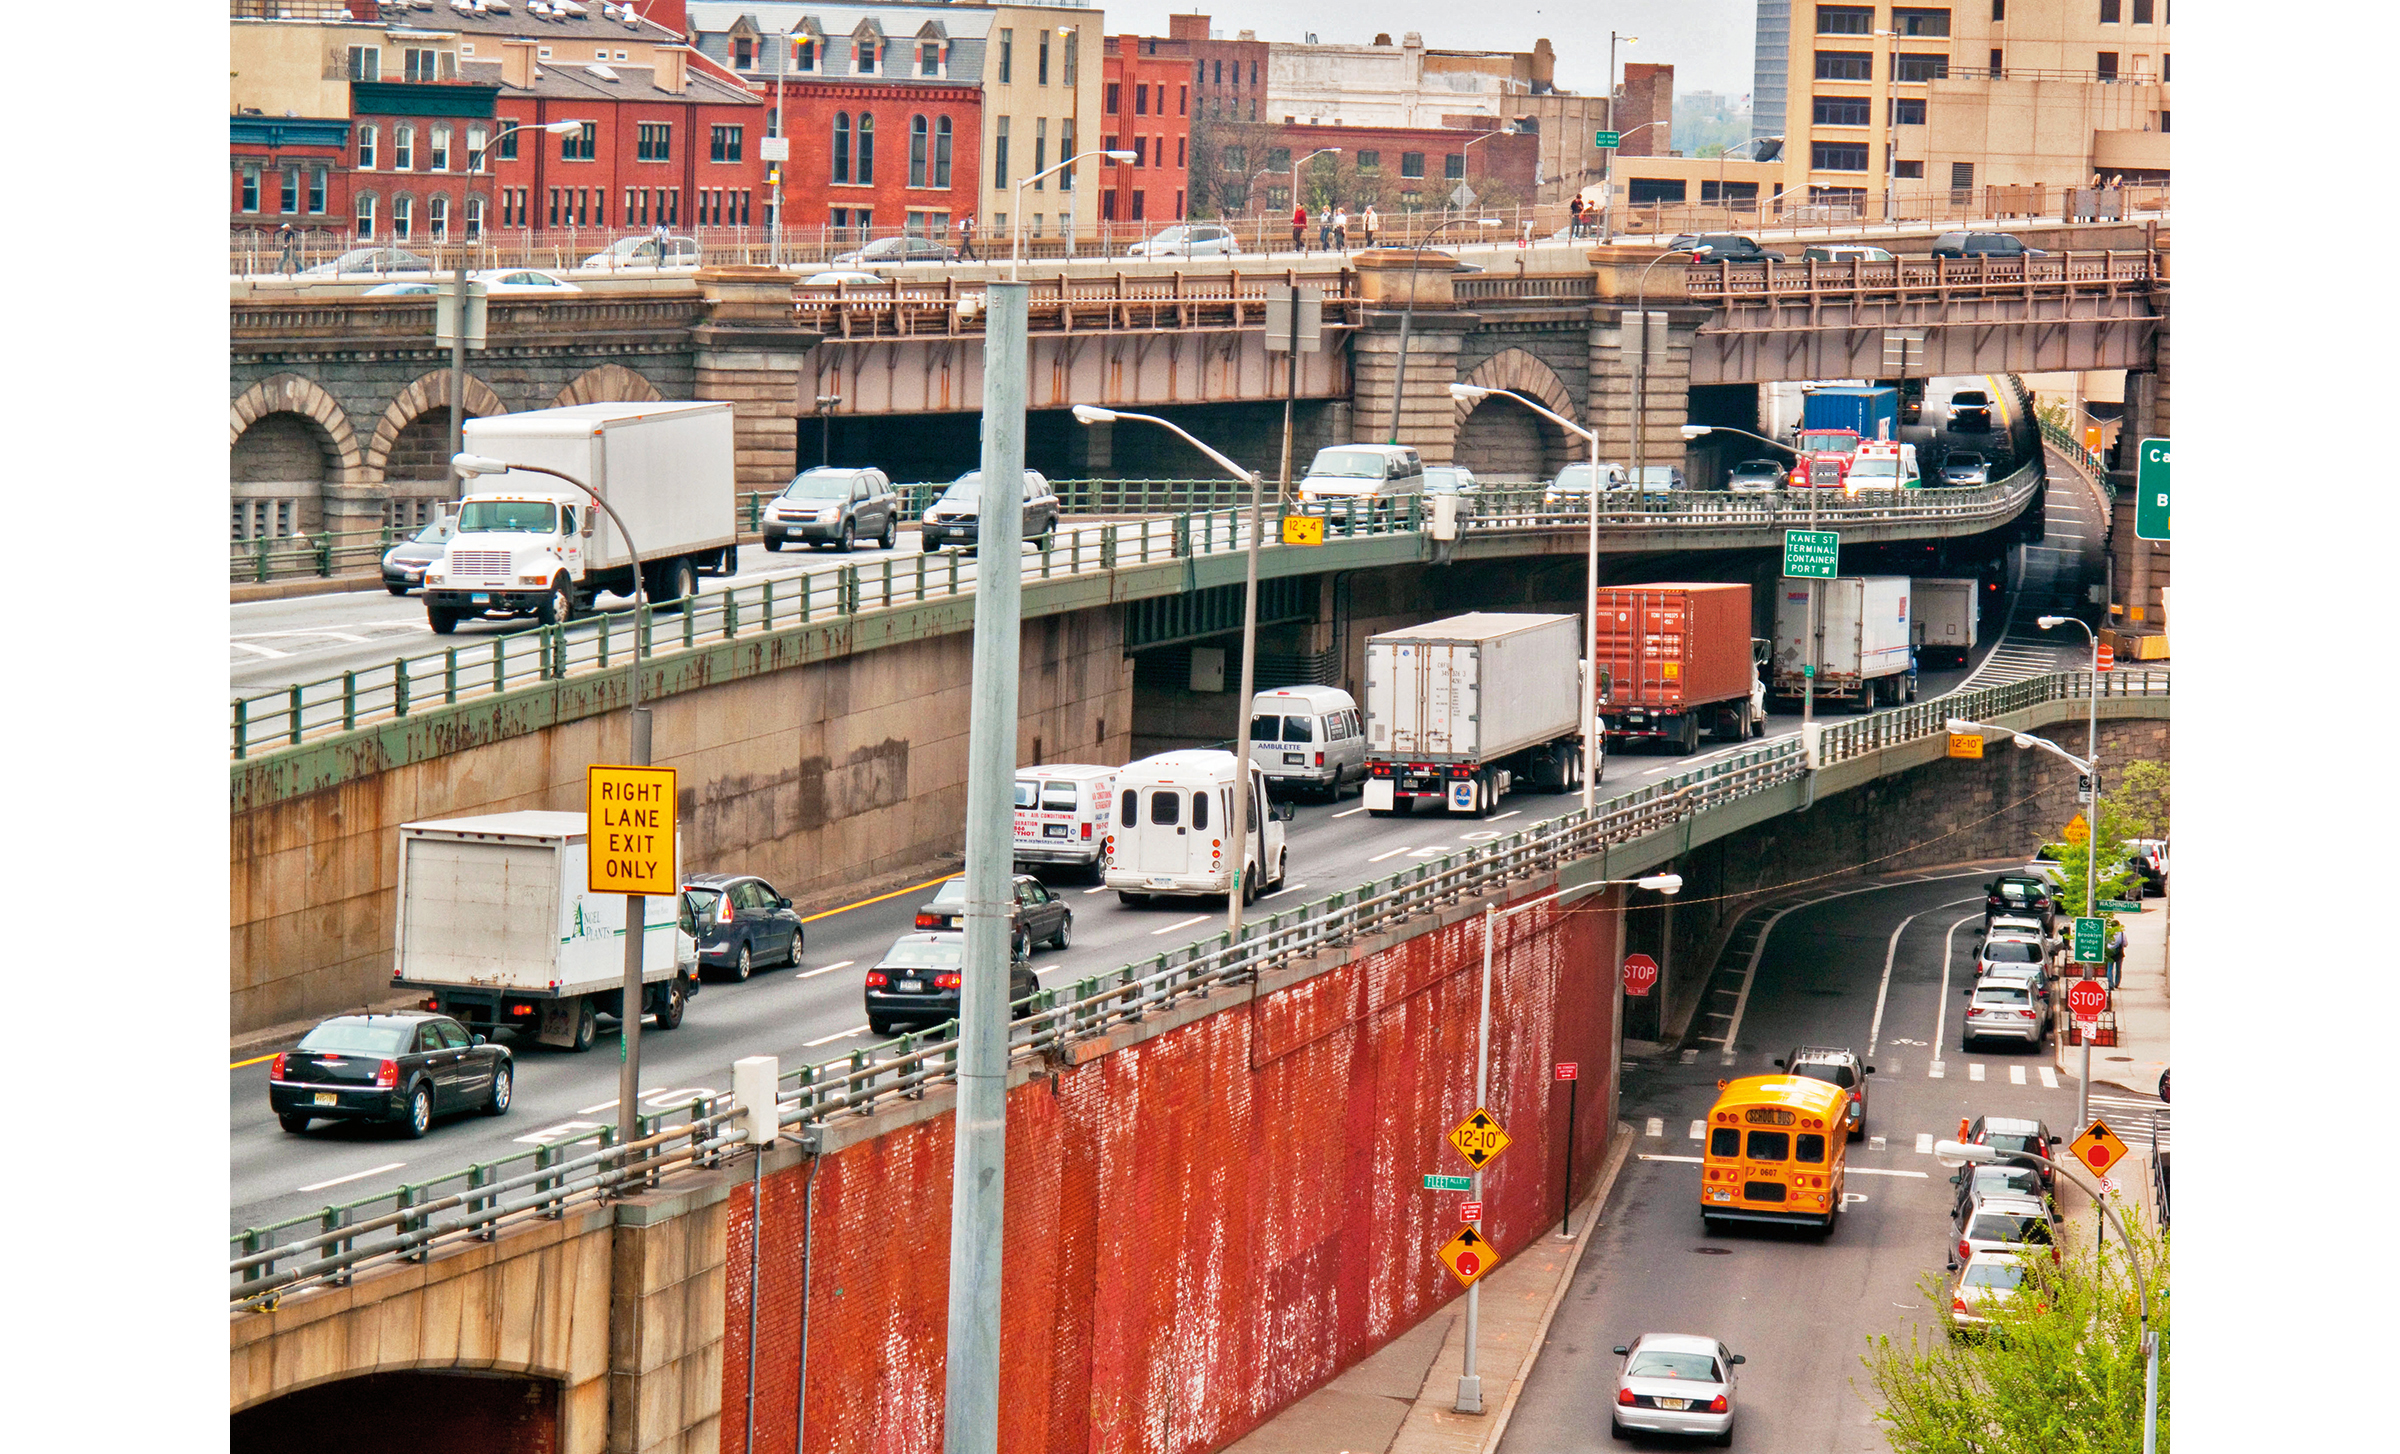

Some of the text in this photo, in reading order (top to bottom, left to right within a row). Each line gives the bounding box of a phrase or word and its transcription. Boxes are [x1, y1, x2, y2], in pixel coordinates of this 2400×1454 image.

[1790, 534, 1834, 544] KANE ST
[1788, 544, 1836, 554] TERMINAL
[1788, 554, 1836, 564] CONTAINER
[1792, 564, 1816, 572] PORT
[1952, 738, 1981, 748] 12'-10"
[602, 782, 662, 802] RIGHT
[604, 808, 659, 828] LANE
[610, 834, 654, 853] EXIT
[606, 859, 658, 879] ONLY
[1624, 966, 1655, 980] STOP
[2072, 991, 2104, 1006] STOP
[1749, 1110, 1791, 1125] SCHOOL BUS
[1459, 1130, 1500, 1148] 12'-10"
[1428, 1176, 1448, 1188] FLEET
